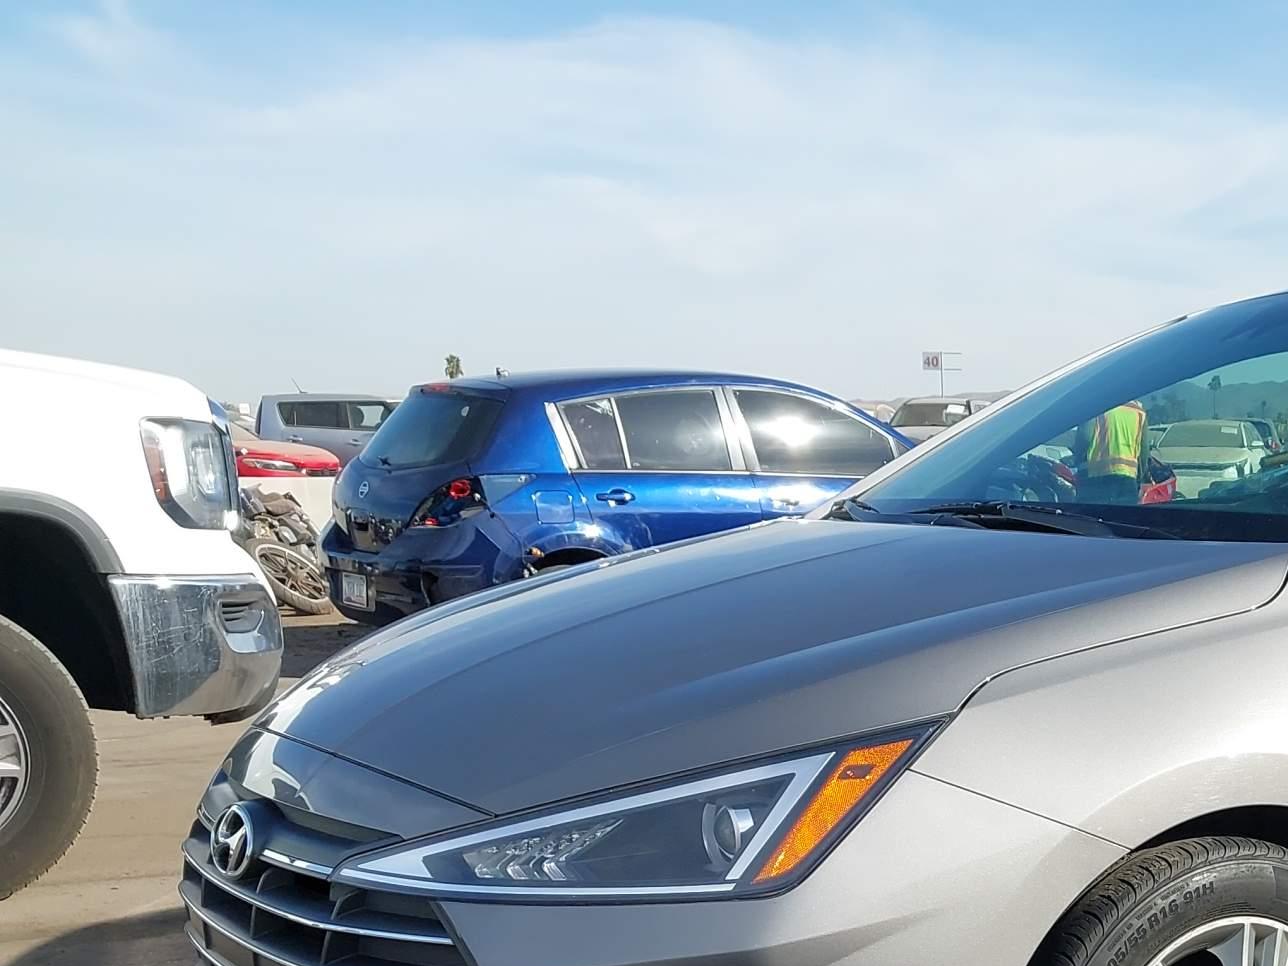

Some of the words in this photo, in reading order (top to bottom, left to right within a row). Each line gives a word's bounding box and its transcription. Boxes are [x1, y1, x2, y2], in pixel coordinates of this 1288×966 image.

[923, 356, 939, 368] 40
[1147, 899, 1180, 930] R16
[1183, 880, 1216, 904] 91H
